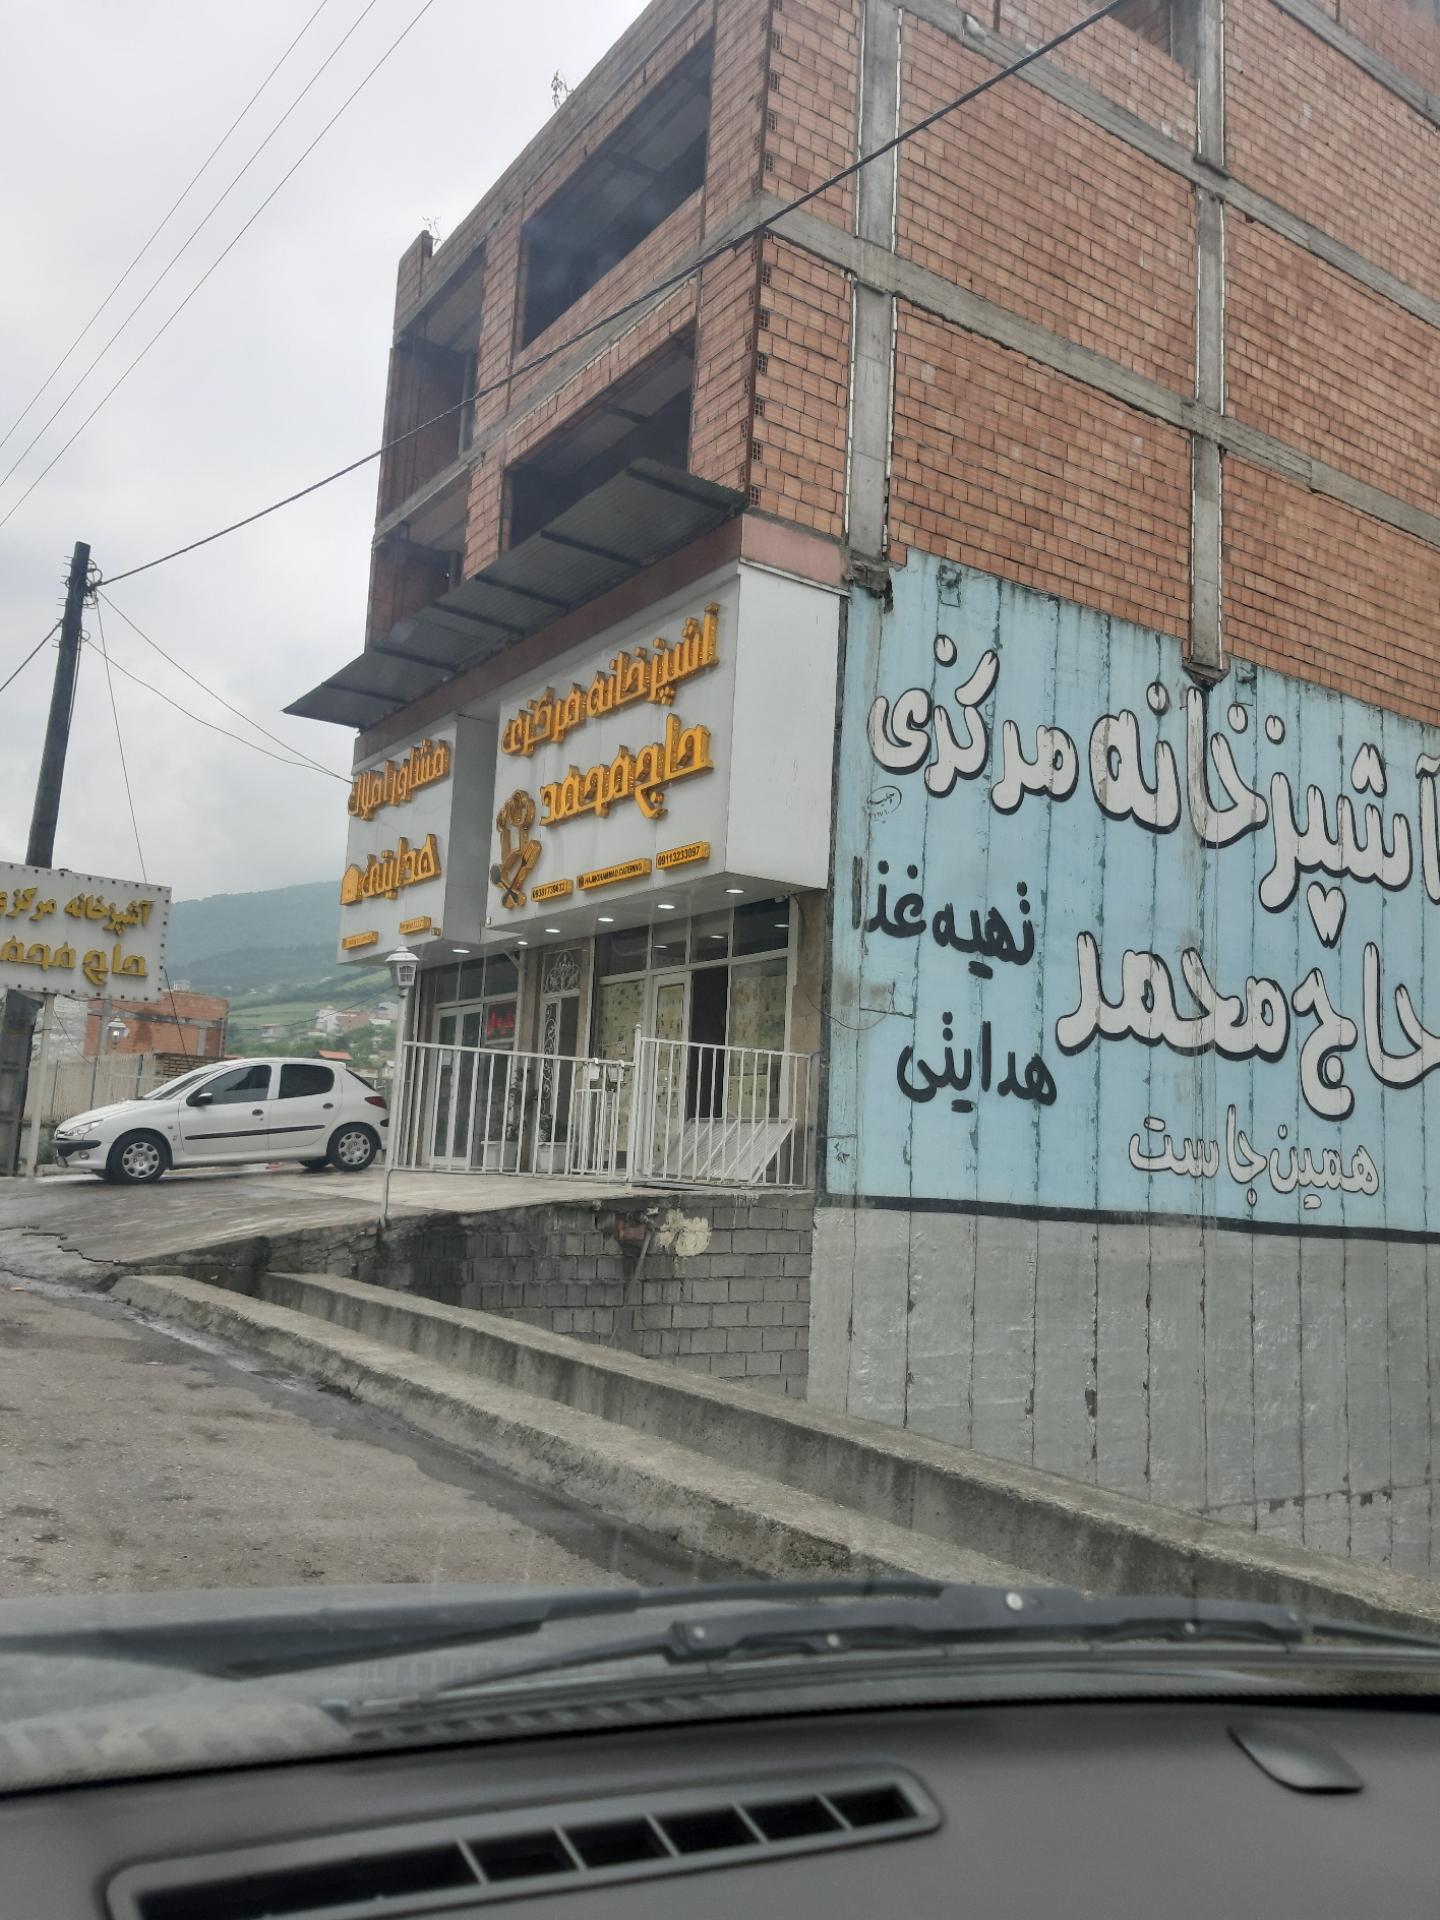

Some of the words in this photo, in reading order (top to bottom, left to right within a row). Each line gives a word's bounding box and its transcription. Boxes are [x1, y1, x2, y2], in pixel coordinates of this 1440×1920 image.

[502, 683, 586, 757] مرکزی
[867, 634, 1078, 815] مرکزی
[539, 745, 637, 827] محمد
[635, 713, 714, 820] حاج
[63, 892, 156, 936] آشپزخانه
[852, 855, 928, 939] غذا
[931, 881, 1035, 980] تهیه
[0, 935, 76, 972] محم
[82, 943, 148, 986] حاج
[1056, 931, 1291, 1063] محمد
[896, 1011, 1058, 1114] هدایتی
